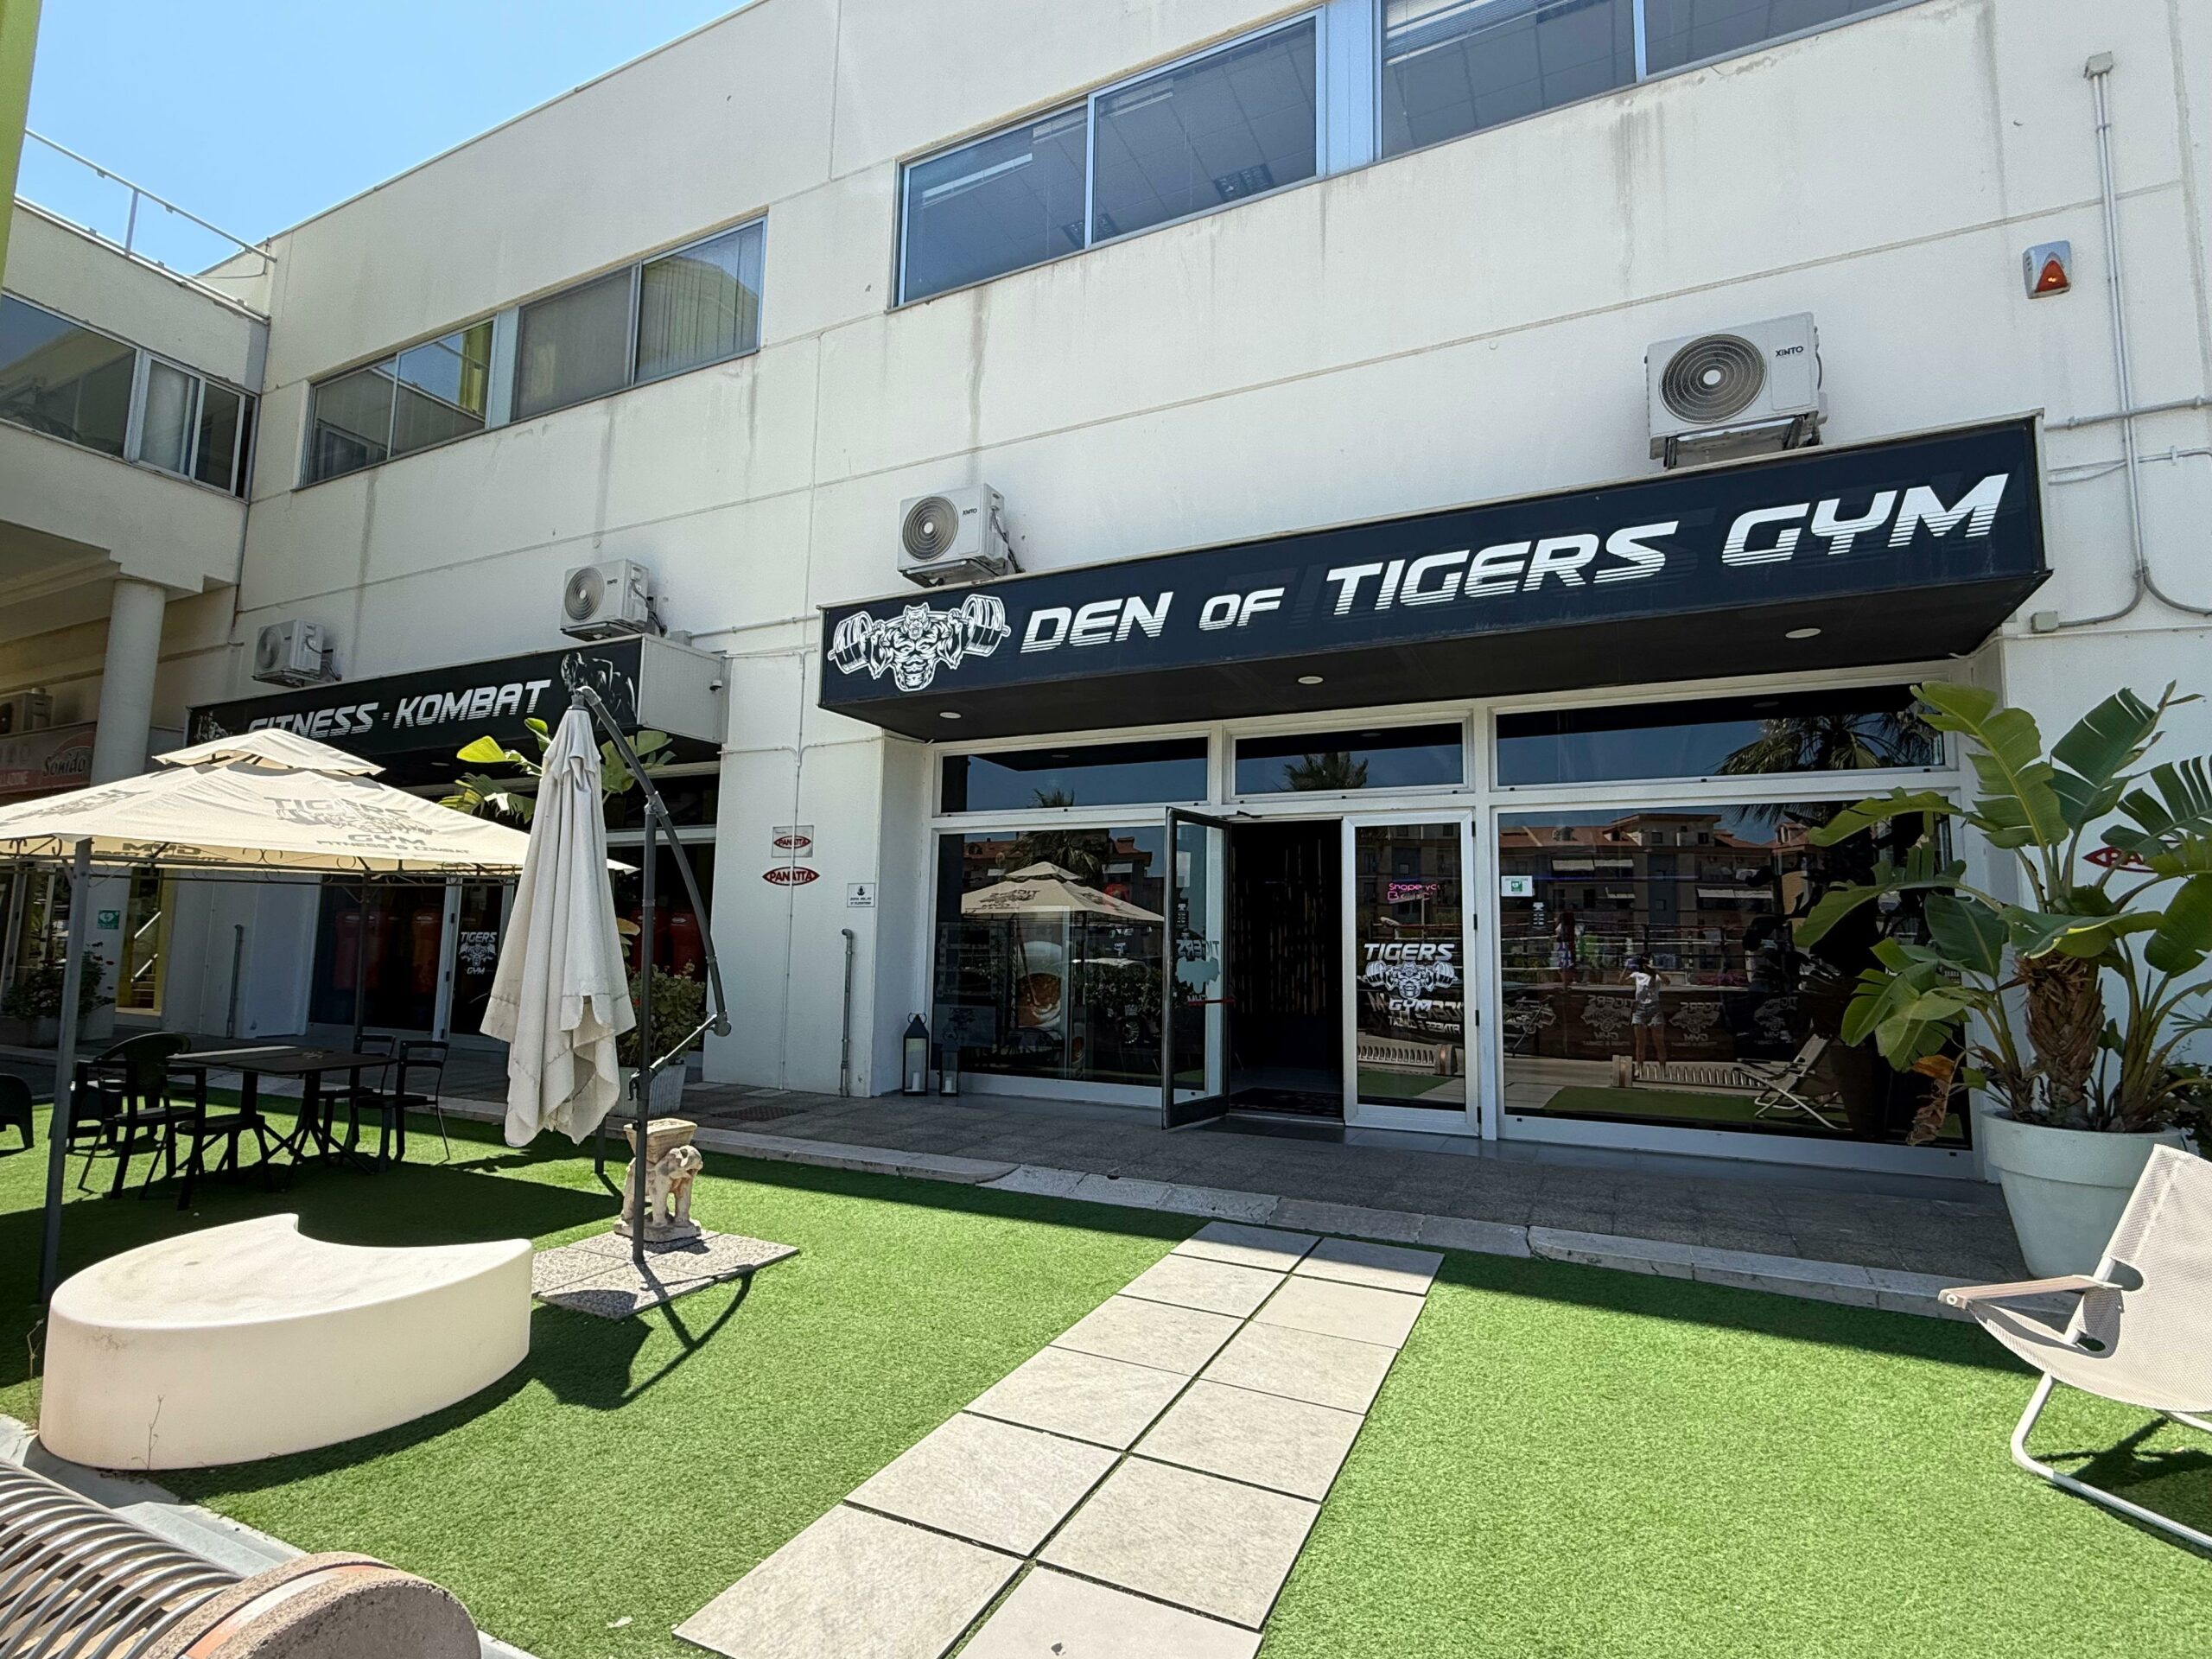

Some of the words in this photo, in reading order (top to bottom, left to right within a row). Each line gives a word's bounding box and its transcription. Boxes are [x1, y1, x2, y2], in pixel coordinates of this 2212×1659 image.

[1775, 345, 1804, 358] XINTO
[1020, 591, 1173, 653] DEN
[1198, 588, 1285, 631] OF
[1325, 520, 1679, 615] TIGERS
[1722, 474, 2009, 566] GYM
[392, 679, 551, 728] KOMBAT
[43, 753, 86, 777] Sonido
[264, 797, 410, 819] TIGERS
[316, 840, 386, 850] FITNESS
[347, 834, 426, 846] GYM
[770, 871, 812, 882] PANATTA
[461, 931, 498, 943] TIGERS
[1363, 943, 1455, 961] TIGERS
[1389, 998, 1433, 1012] GYM
